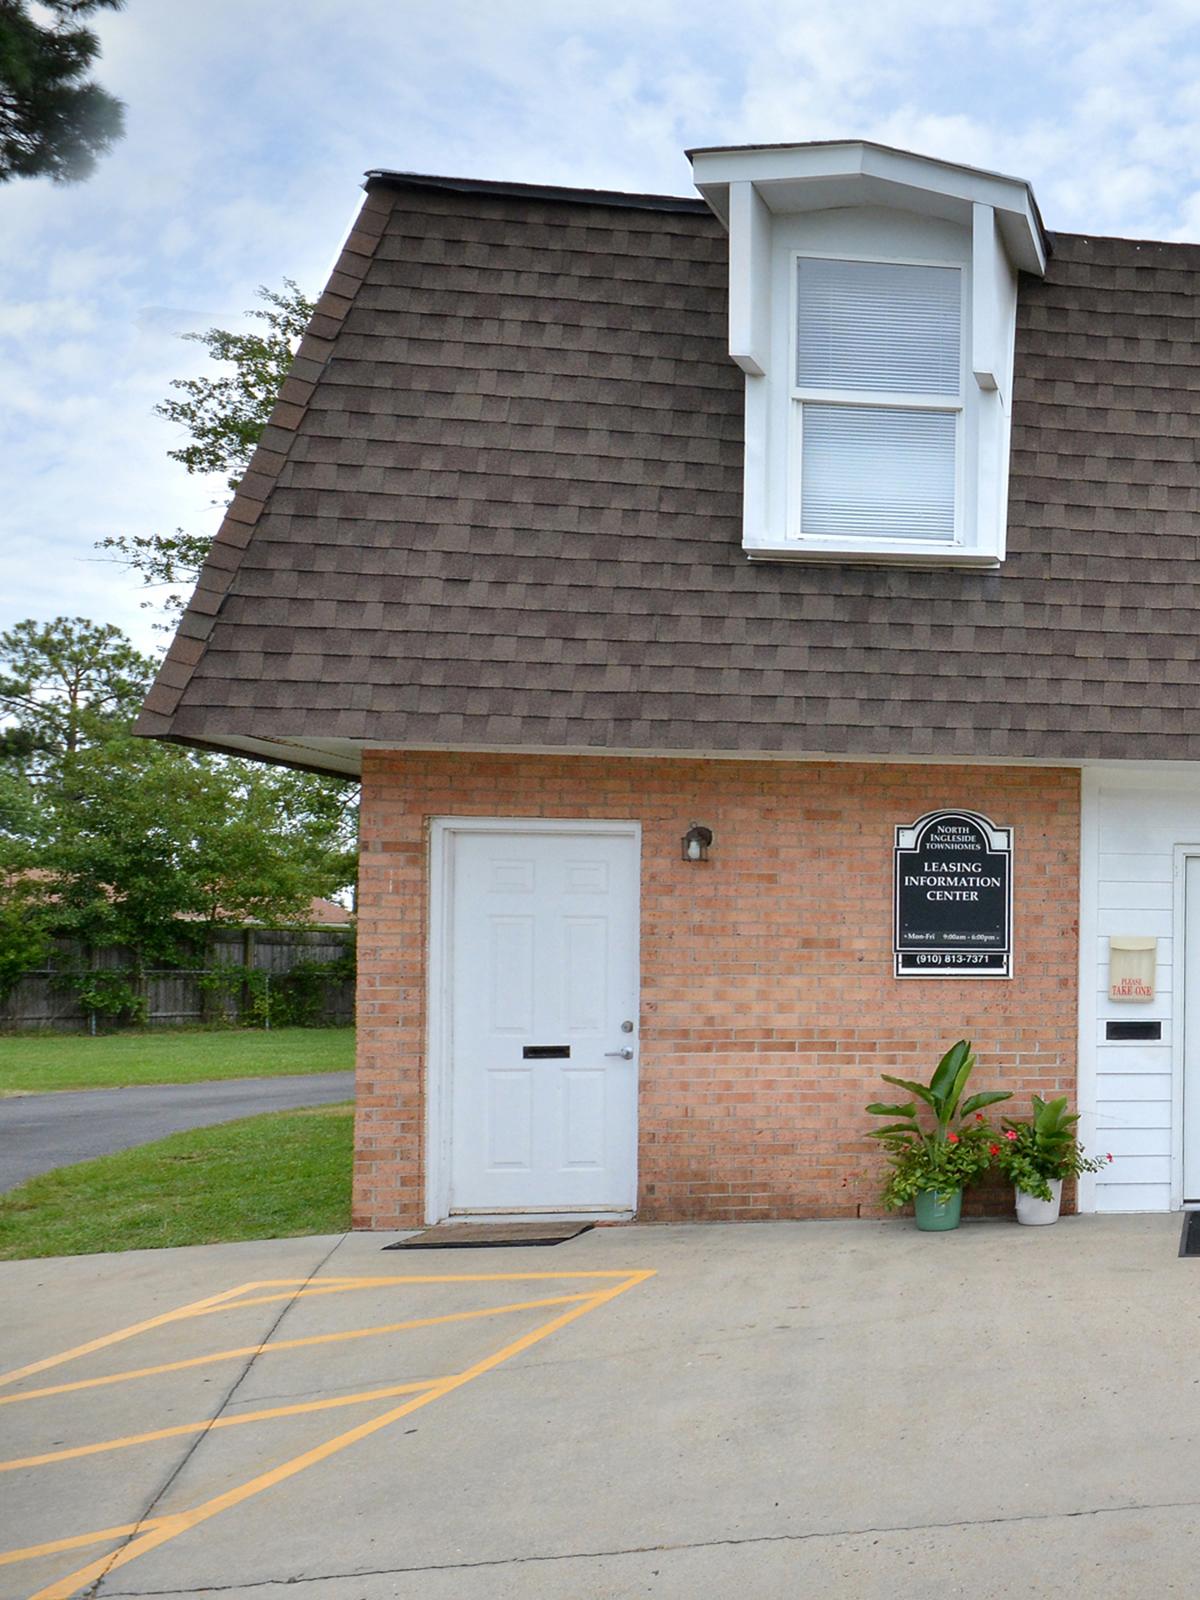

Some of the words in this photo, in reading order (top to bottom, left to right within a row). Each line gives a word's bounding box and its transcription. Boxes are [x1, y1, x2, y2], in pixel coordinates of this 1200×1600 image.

[937, 825, 970, 834] NORTH
[930, 834, 977, 842] INGLESIDE
[925, 842, 981, 851] TOWNHOMES
[924, 862, 982, 873] LEASING
[904, 876, 1001, 887] INFORMATION
[926, 890, 979, 901] CENTER
[916, 954, 942, 965] (910)
[944, 955, 989, 964] 813-7371
[1121, 978, 1142, 986] PLEASE
[1112, 985, 1133, 996] TAKE
[1135, 986, 1152, 996] ONE
